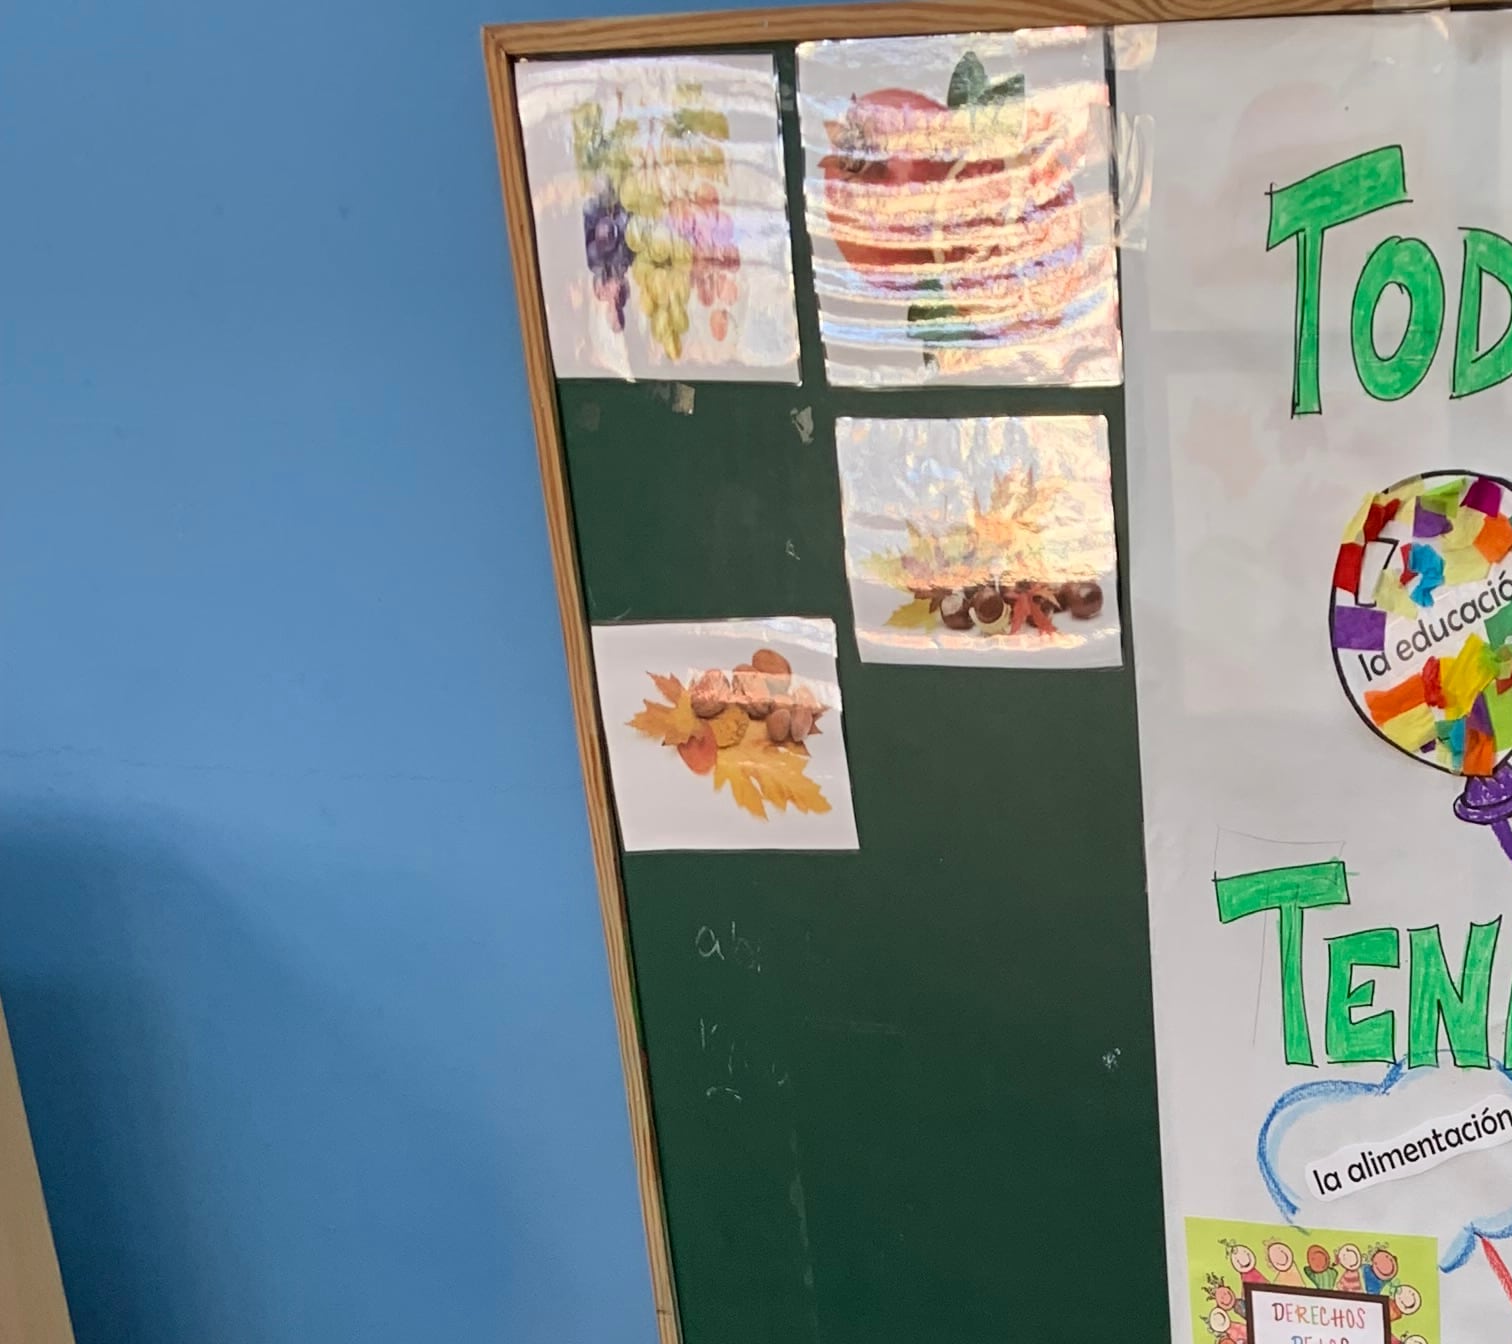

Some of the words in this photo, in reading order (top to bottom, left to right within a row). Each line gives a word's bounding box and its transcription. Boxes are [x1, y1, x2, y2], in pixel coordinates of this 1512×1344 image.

[1358, 650, 1392, 682] la
[1312, 1168, 1343, 1196] la
[1271, 1301, 1367, 1330] DERECHOS
